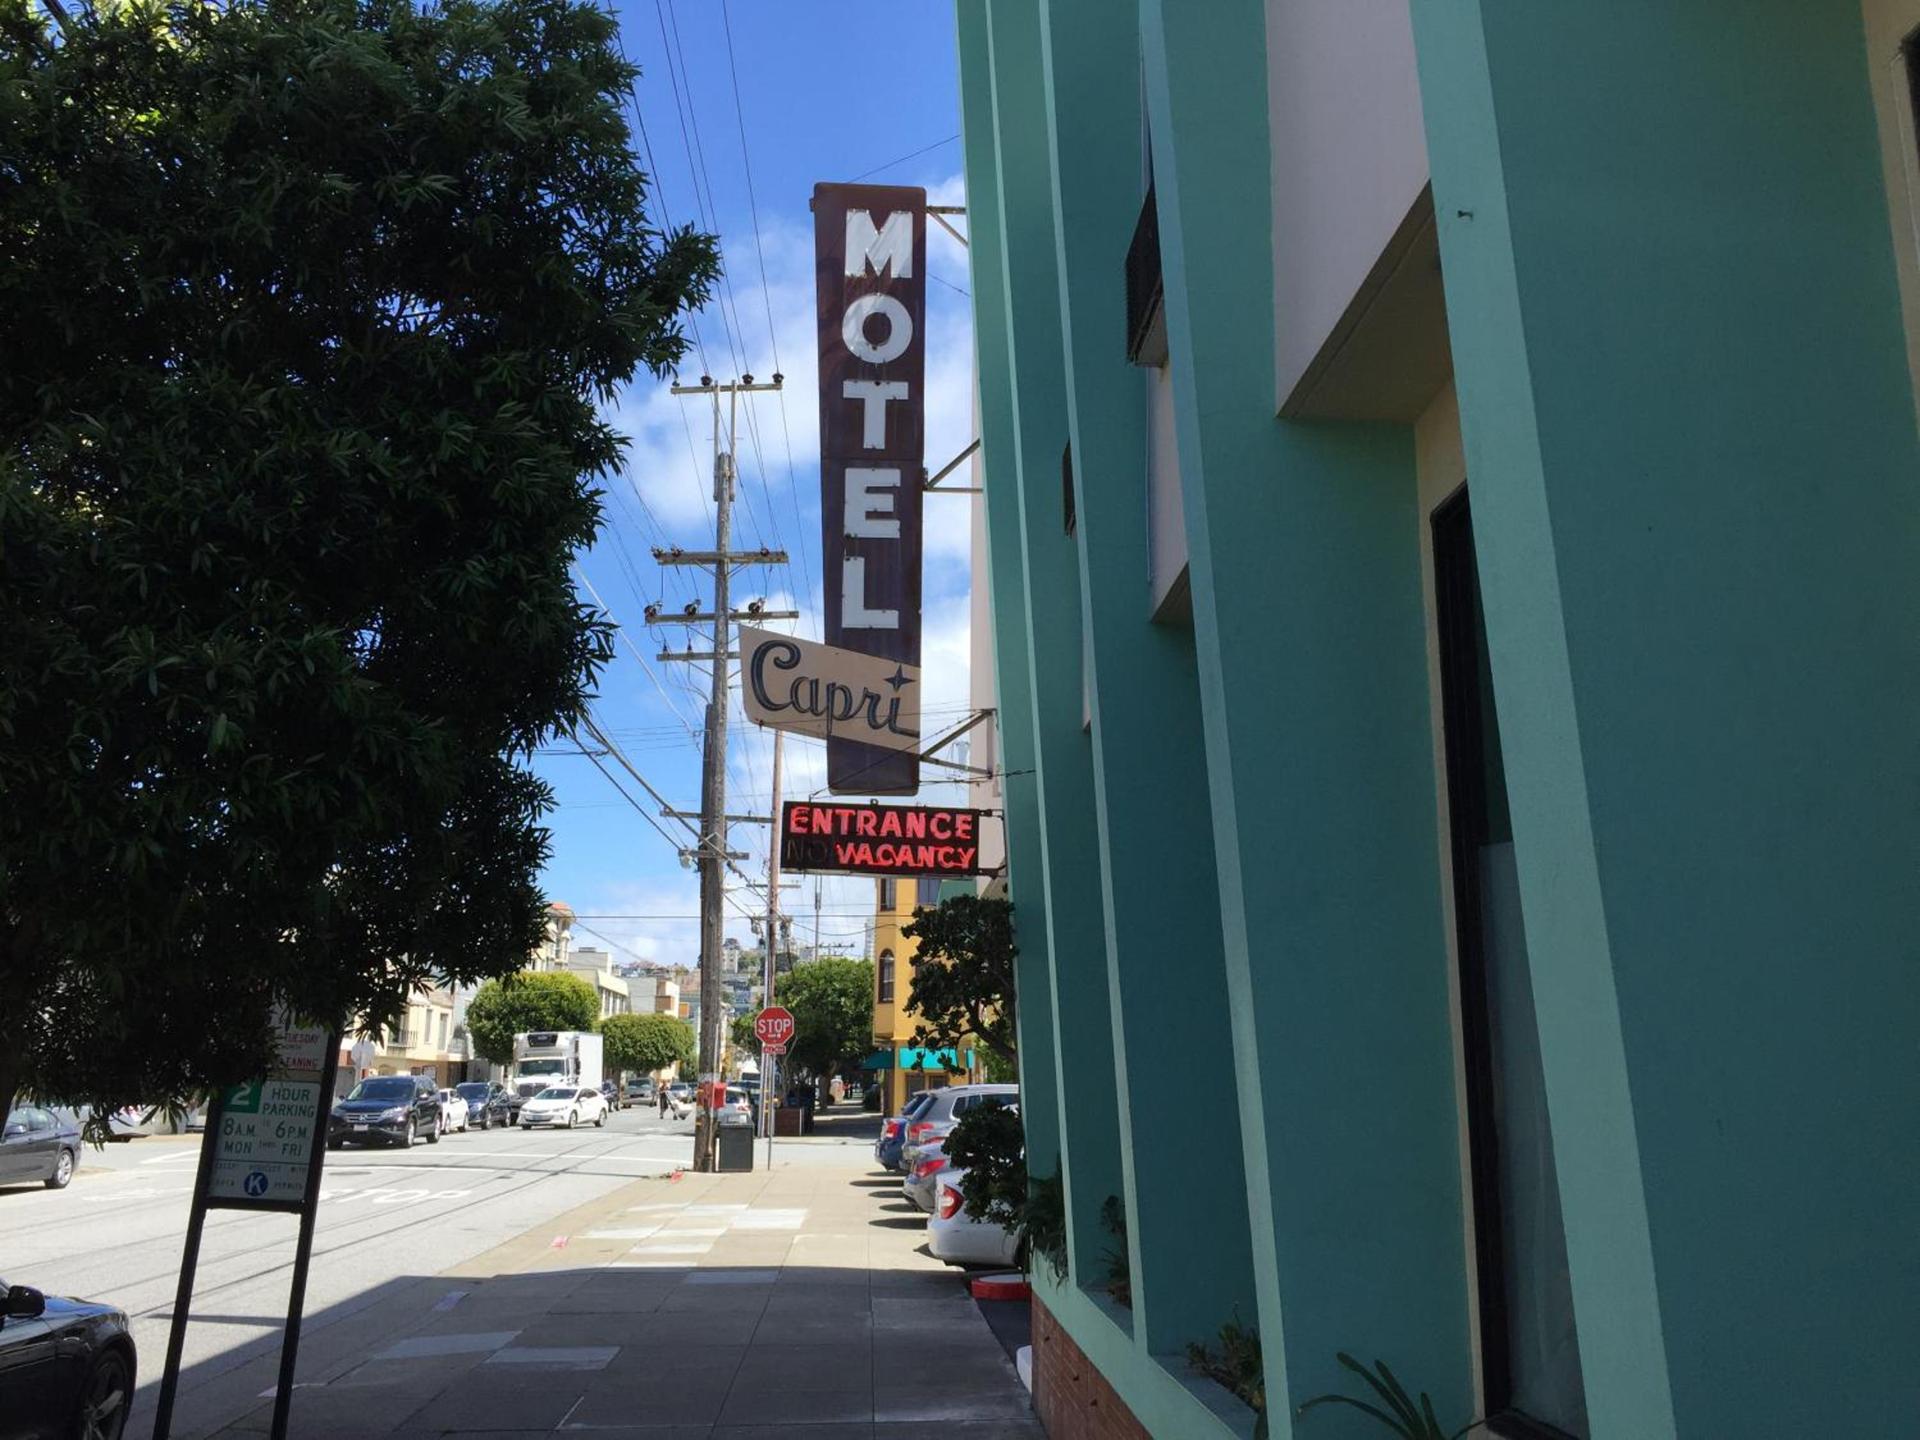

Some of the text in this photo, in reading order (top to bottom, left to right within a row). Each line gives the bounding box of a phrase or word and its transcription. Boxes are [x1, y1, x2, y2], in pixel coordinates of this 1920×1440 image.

[841, 208, 914, 629] MOTEL
[751, 639, 920, 739] Capri
[789, 806, 973, 840] ENTRANCE
[836, 842, 976, 869] VACANCY
[758, 1018, 792, 1034] STOP
[230, 1082, 311, 1106] 2 HOUR
[262, 1103, 316, 1118] PARKING
[224, 1141, 253, 1154] MON
[281, 1143, 303, 1157] FRI
[247, 1175, 264, 1194] K
